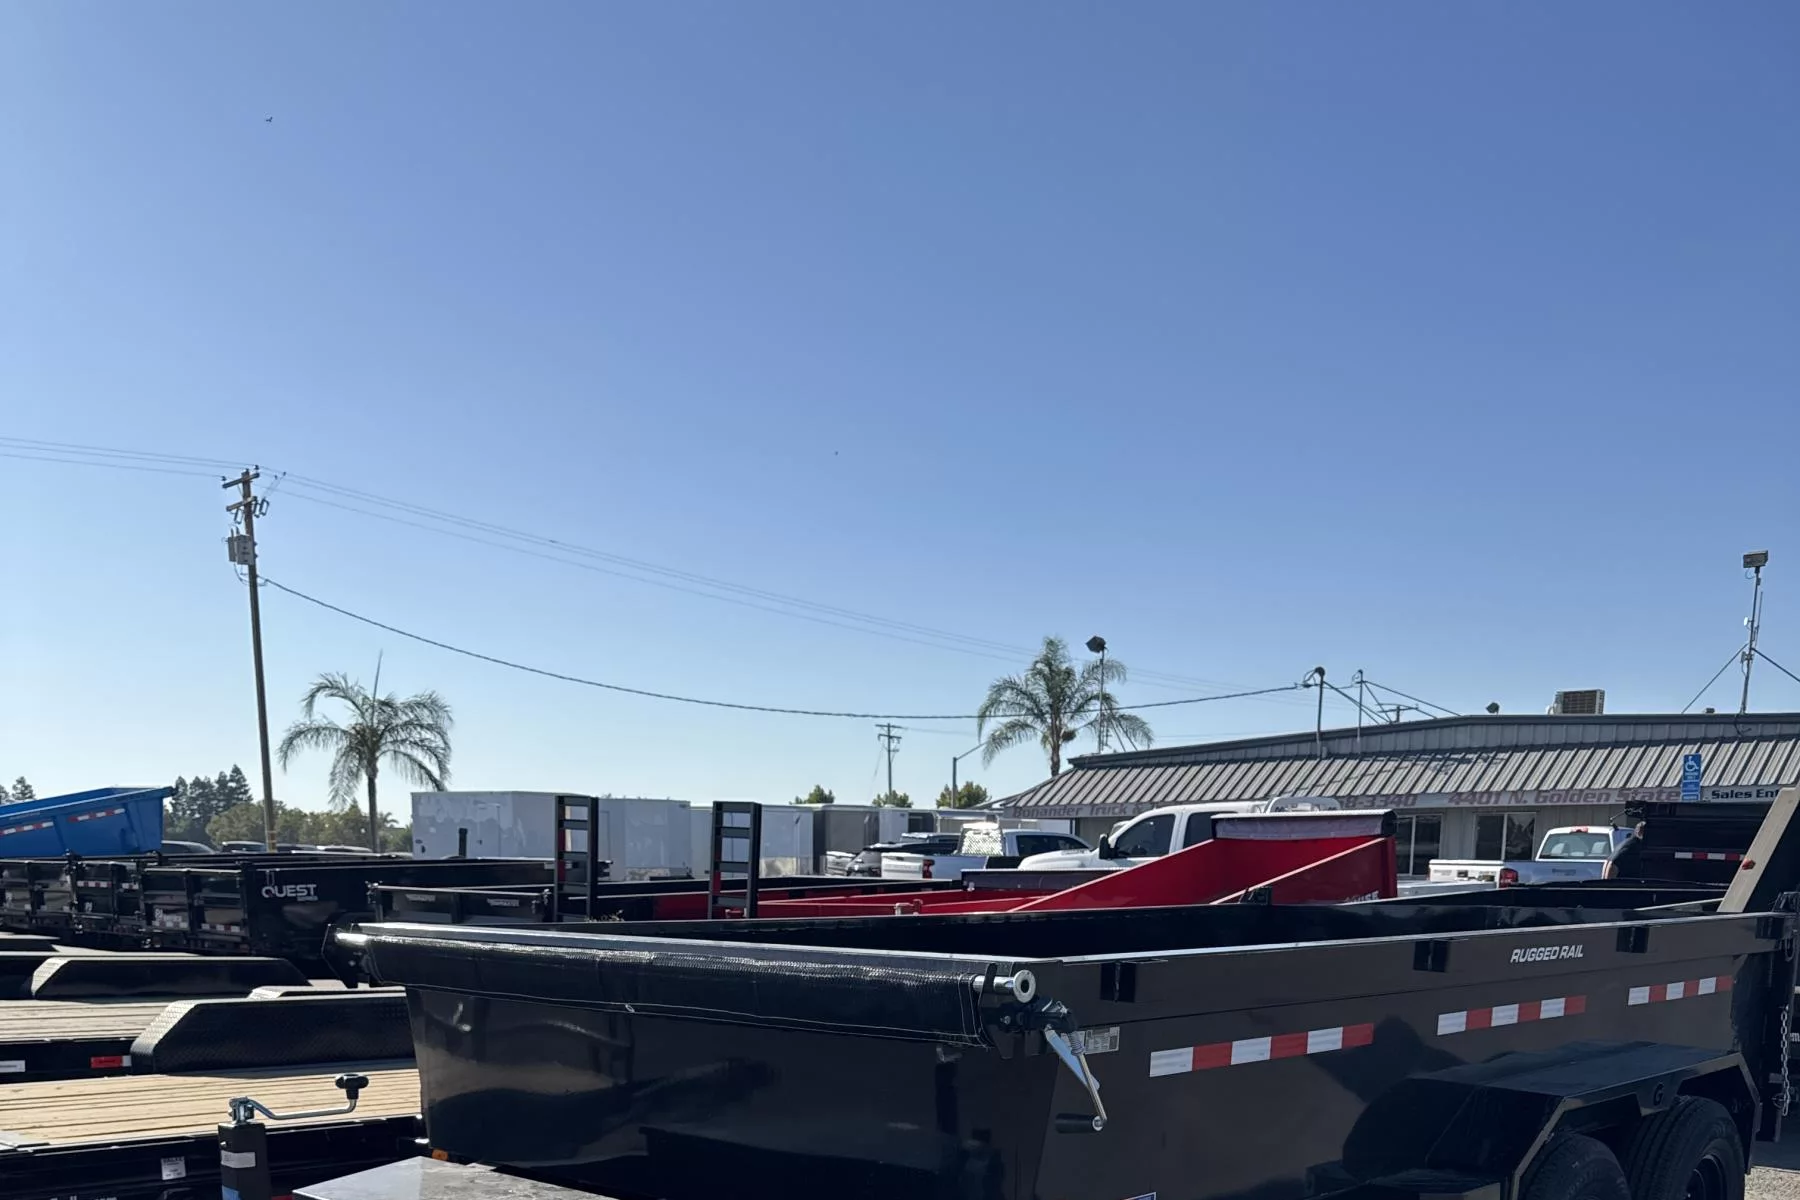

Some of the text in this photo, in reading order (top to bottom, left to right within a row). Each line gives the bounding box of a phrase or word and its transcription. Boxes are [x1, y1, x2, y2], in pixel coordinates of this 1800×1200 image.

[1448, 792, 1502, 805] 4401
[1507, 791, 1528, 805] N.
[1534, 790, 1611, 804] Golden
[1617, 788, 1681, 801] State
[1711, 789, 1752, 799] Sales
[1012, 804, 1083, 818] Bonander
[1089, 803, 1127, 816] Truck
[261, 884, 317, 898] QUEST
[1510, 944, 1584, 963] RUGGED RAIL
